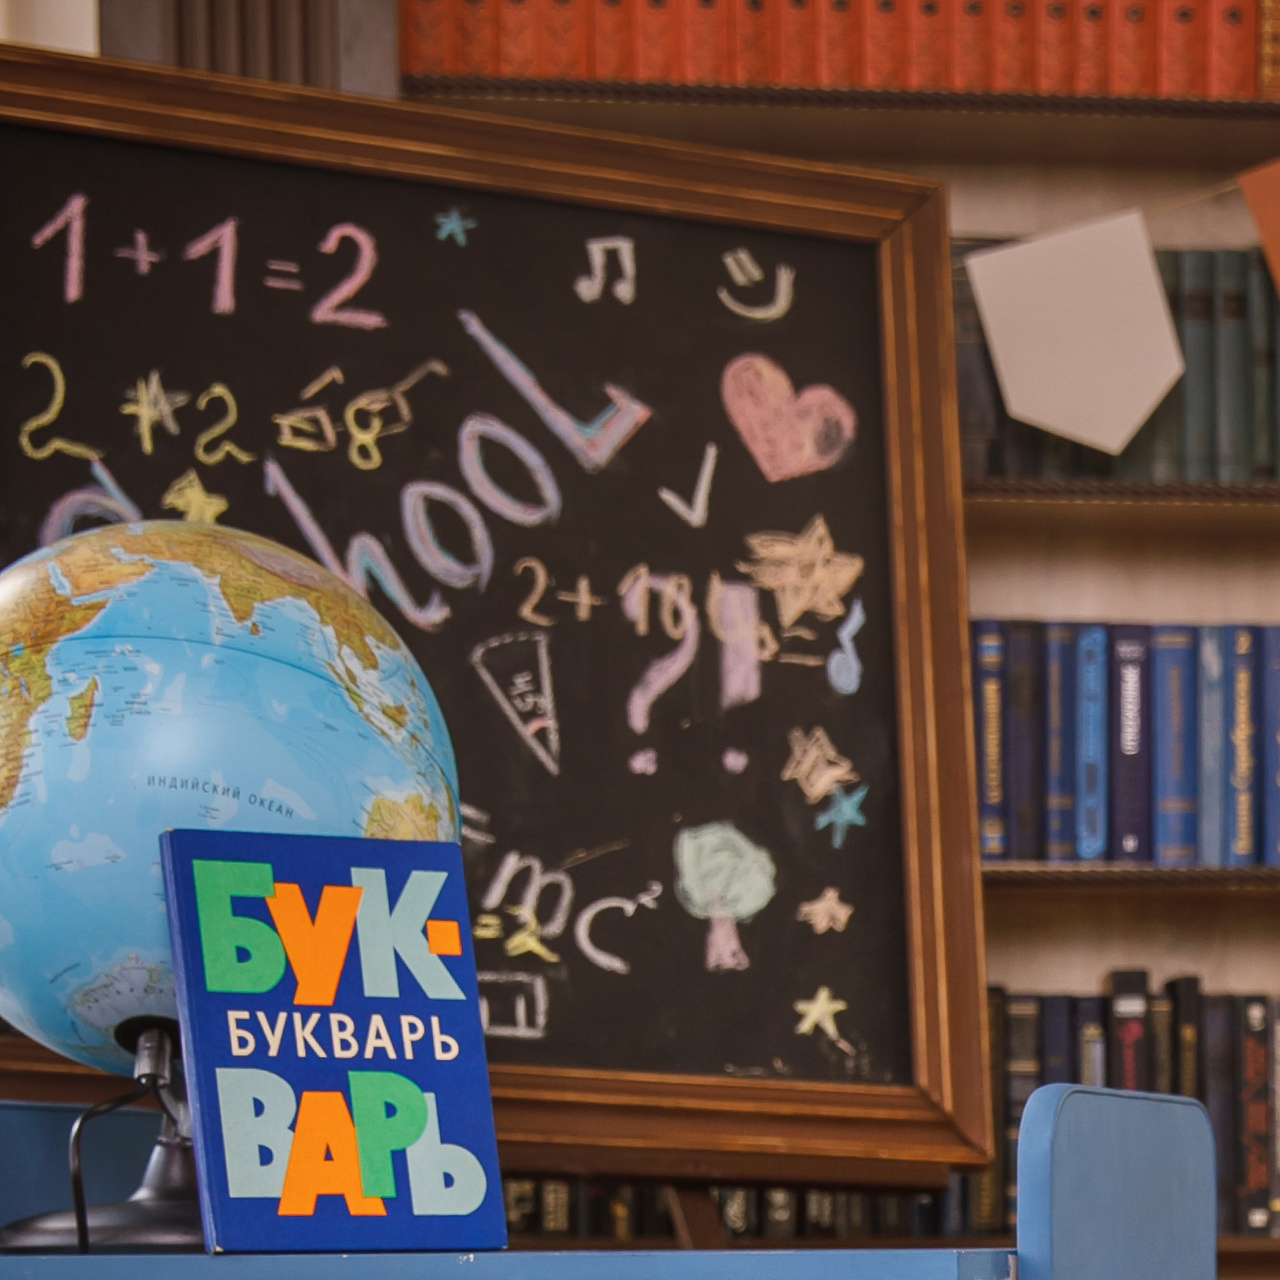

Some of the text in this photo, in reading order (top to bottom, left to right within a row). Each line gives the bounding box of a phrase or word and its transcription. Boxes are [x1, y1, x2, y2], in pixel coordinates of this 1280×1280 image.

[146, 775, 295, 820] ИНДИЙСКИЙ ОКЕАН
[228, 1009, 461, 1062] БУКВАРЬ
